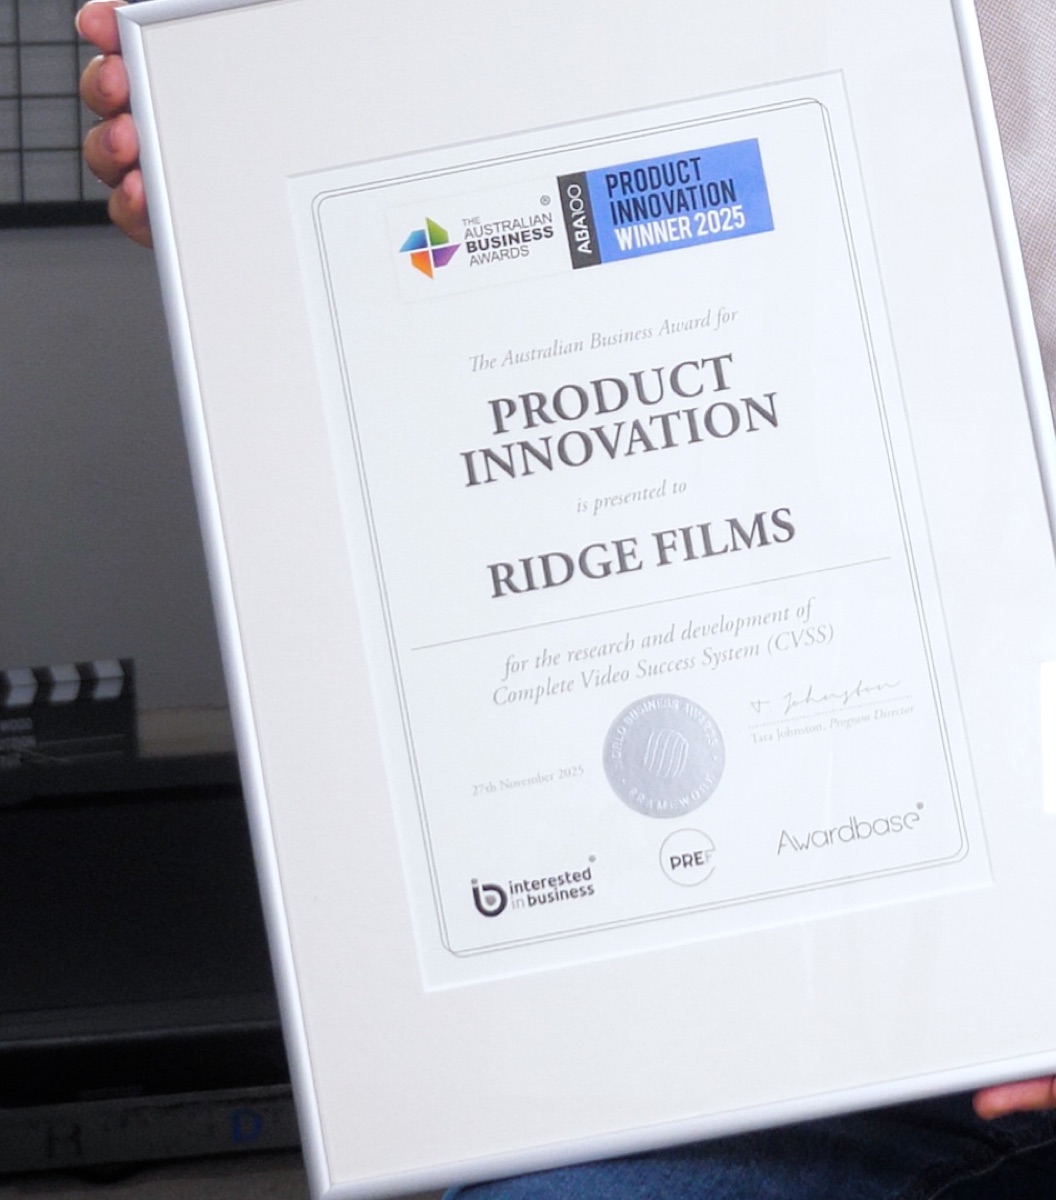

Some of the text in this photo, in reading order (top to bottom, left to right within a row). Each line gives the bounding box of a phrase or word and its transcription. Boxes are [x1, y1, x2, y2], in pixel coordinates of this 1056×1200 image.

[605, 156, 702, 198] PRODUCT
[461, 216, 481, 227] THE
[567, 184, 593, 254] ABA100
[609, 179, 738, 226] INNOVATION
[464, 212, 553, 240] AUSTRALIAN
[466, 225, 555, 253] BUSINESS
[614, 204, 746, 252] WINNER 2025
[470, 245, 530, 267] AWARDS
[469, 306, 740, 373] The Australian Business Award for
[487, 353, 734, 435] PRODUCT
[460, 392, 779, 487] INNOVATION
[577, 479, 688, 517] is presented to
[486, 507, 797, 599] RIDGE FILMS
[501, 596, 817, 682] for the research and development of
[492, 624, 835, 707] Complete Video Success System (CVSS)
[750, 732, 774, 745] Tara
[829, 714, 871, 731] Program
[873, 705, 915, 721] Director
[471, 764, 585, 797] 27th November 2025
[777, 810, 921, 856] Awardbase
[508, 866, 592, 896] interested
[511, 882, 596, 910] in business
